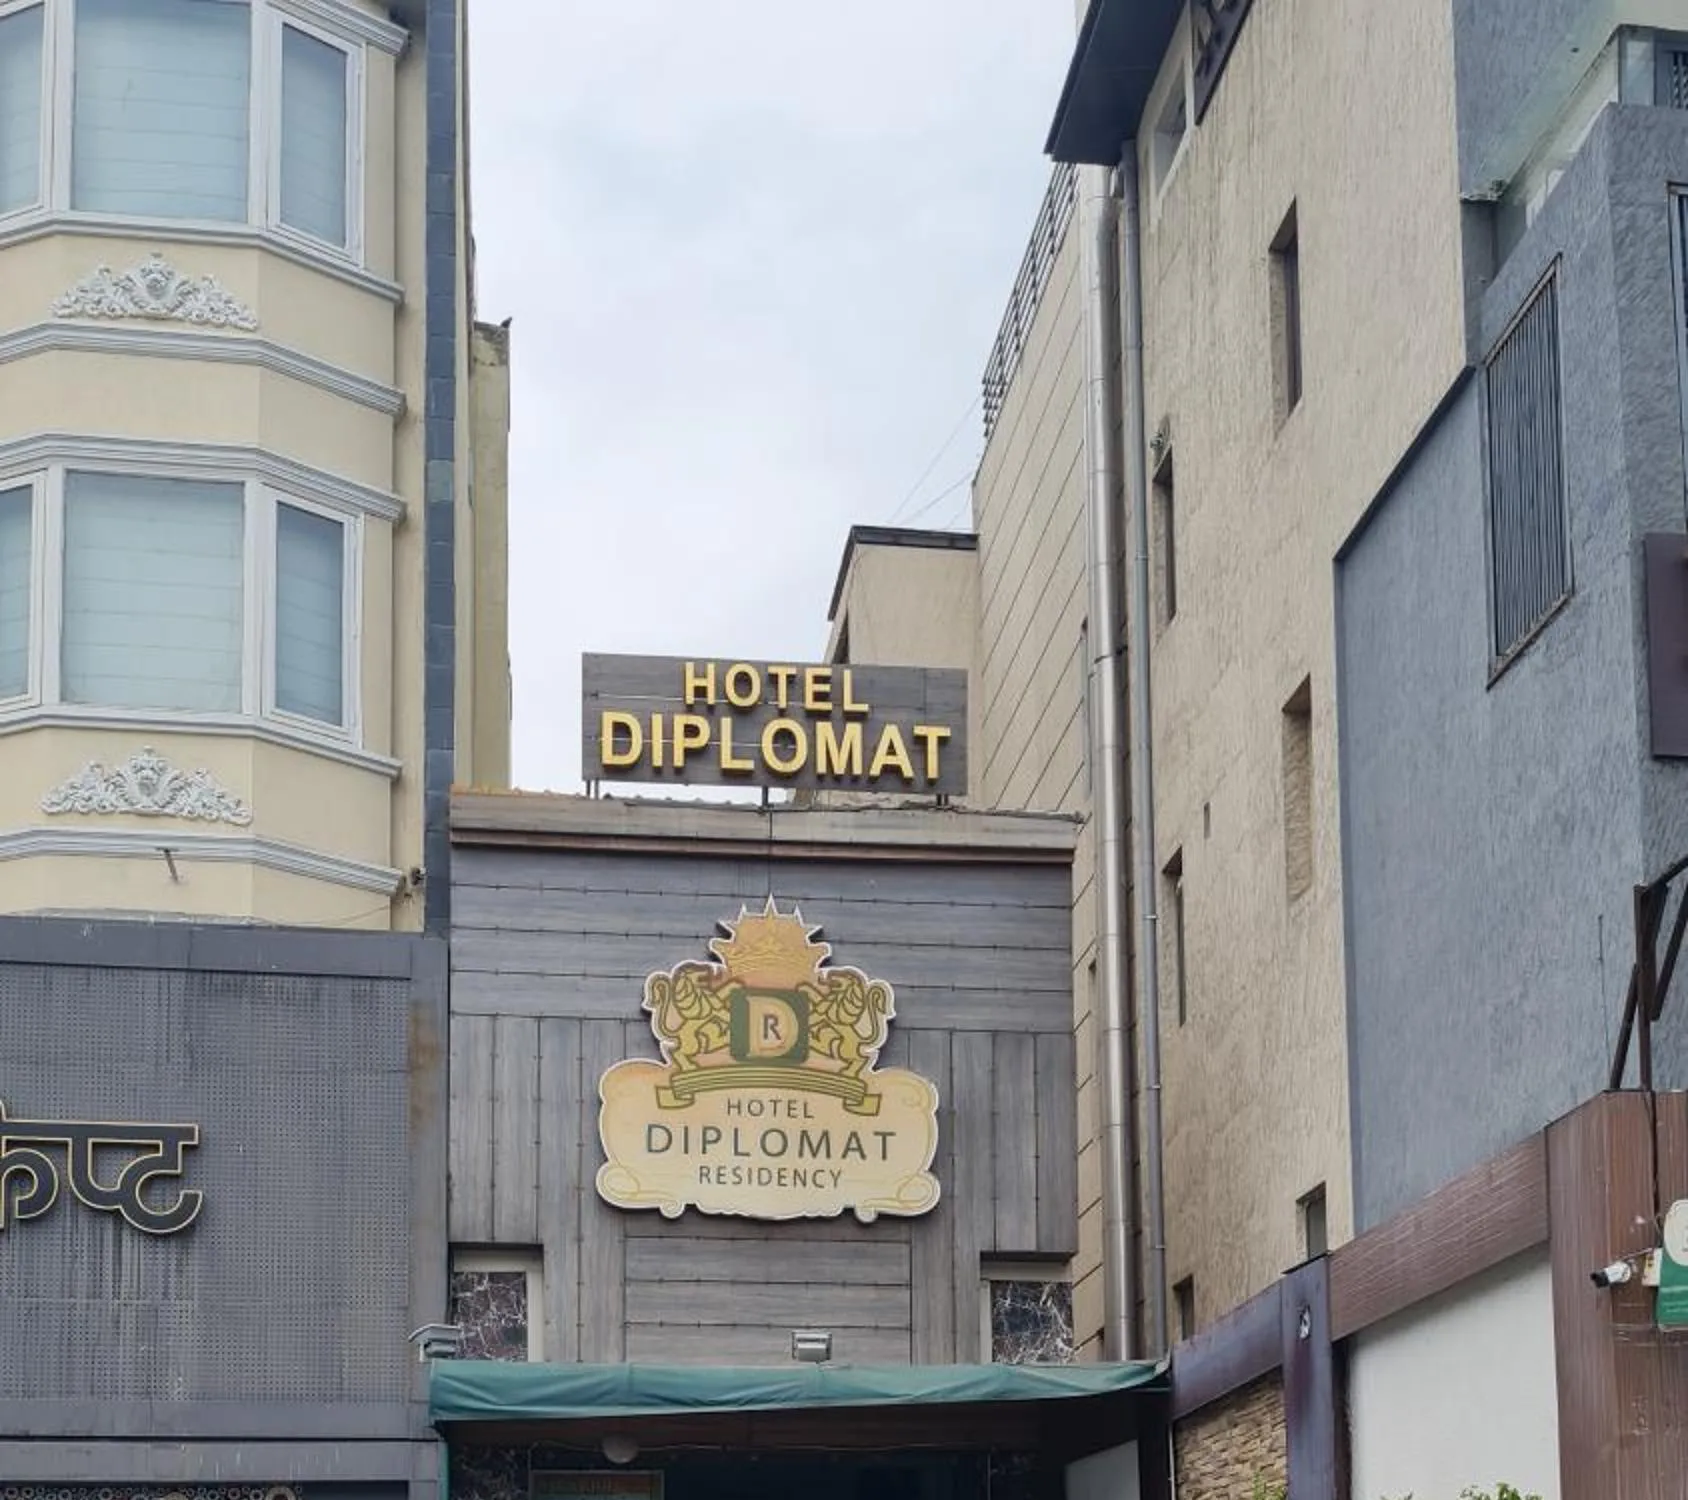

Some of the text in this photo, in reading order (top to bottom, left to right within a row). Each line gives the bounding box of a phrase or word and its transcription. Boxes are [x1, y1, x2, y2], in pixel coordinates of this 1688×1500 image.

[684, 661, 870, 713] HOTEL
[601, 711, 952, 781] DIPLOMAT
[763, 1014, 782, 1041] R
[727, 1098, 816, 1120] HOTEL
[645, 1123, 897, 1162] DIPLOMAT
[698, 1165, 843, 1190] RESIDENCY
